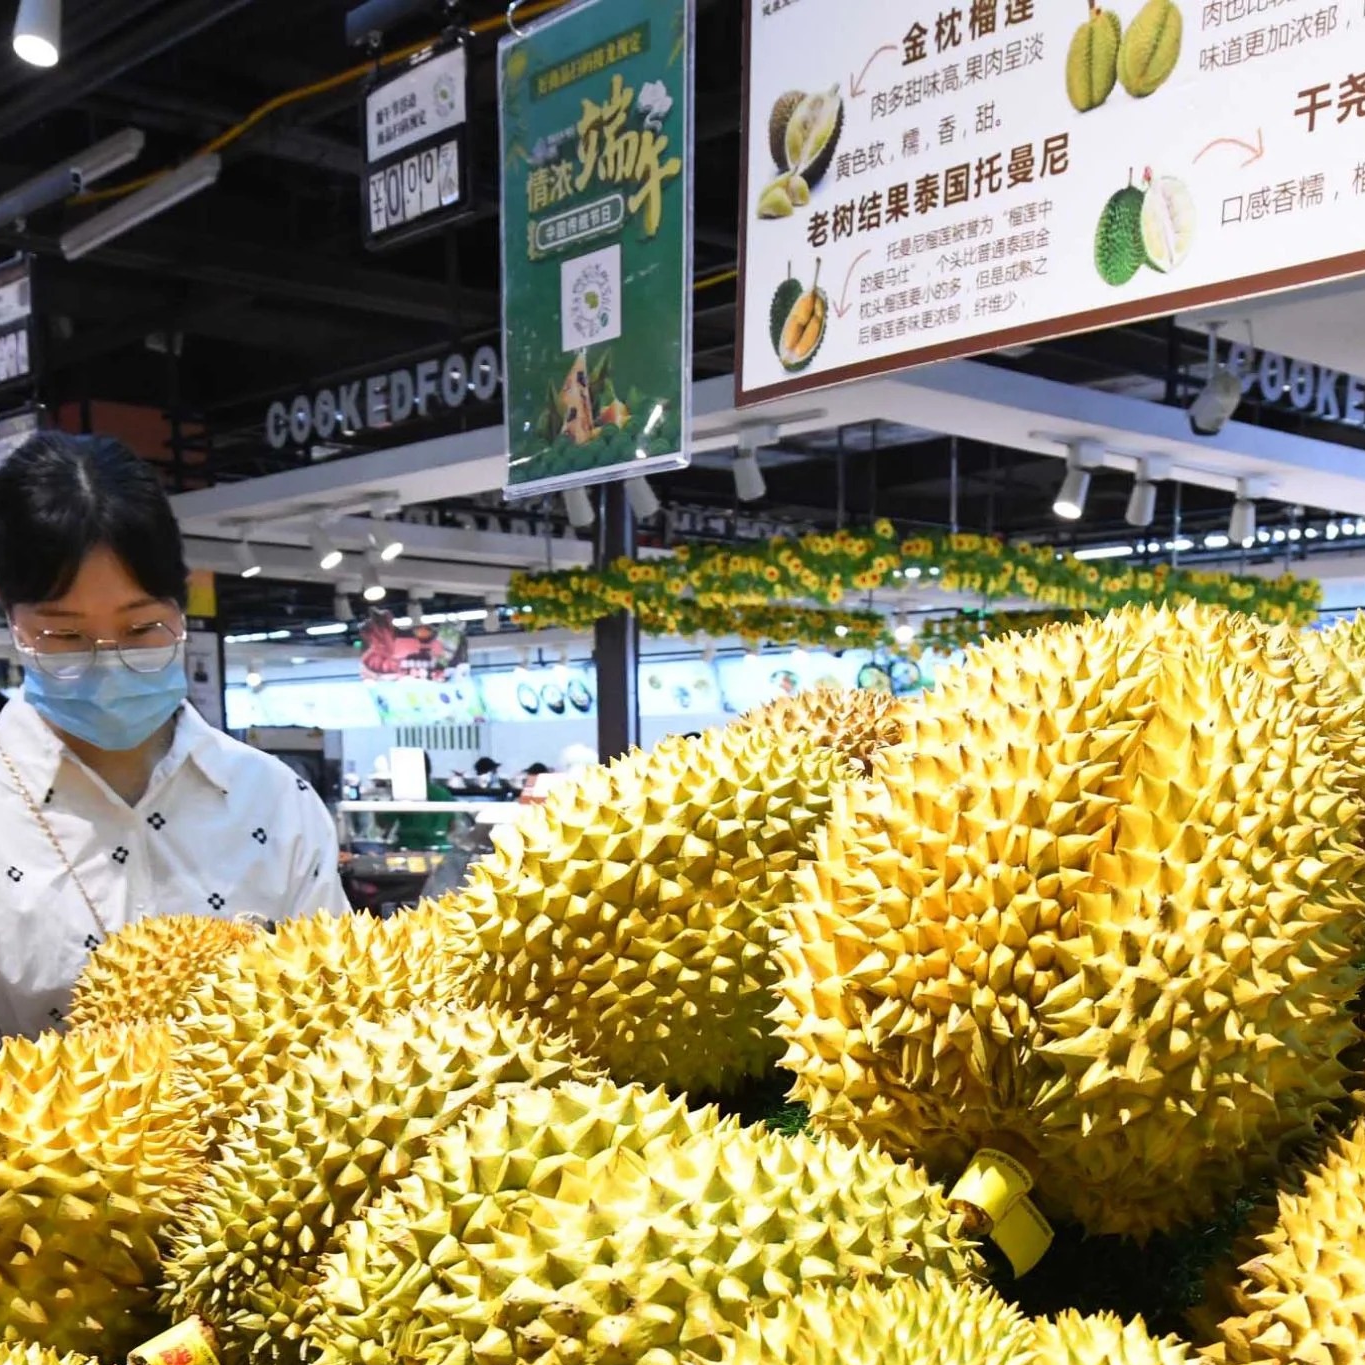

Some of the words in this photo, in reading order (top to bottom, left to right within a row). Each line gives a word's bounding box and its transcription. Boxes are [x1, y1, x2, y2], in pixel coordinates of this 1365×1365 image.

[901, 0, 1034, 66] 金枕榴莲
[527, 159, 574, 212] 情浓
[807, 132, 1069, 248] 老树结果泰国托曼尼
